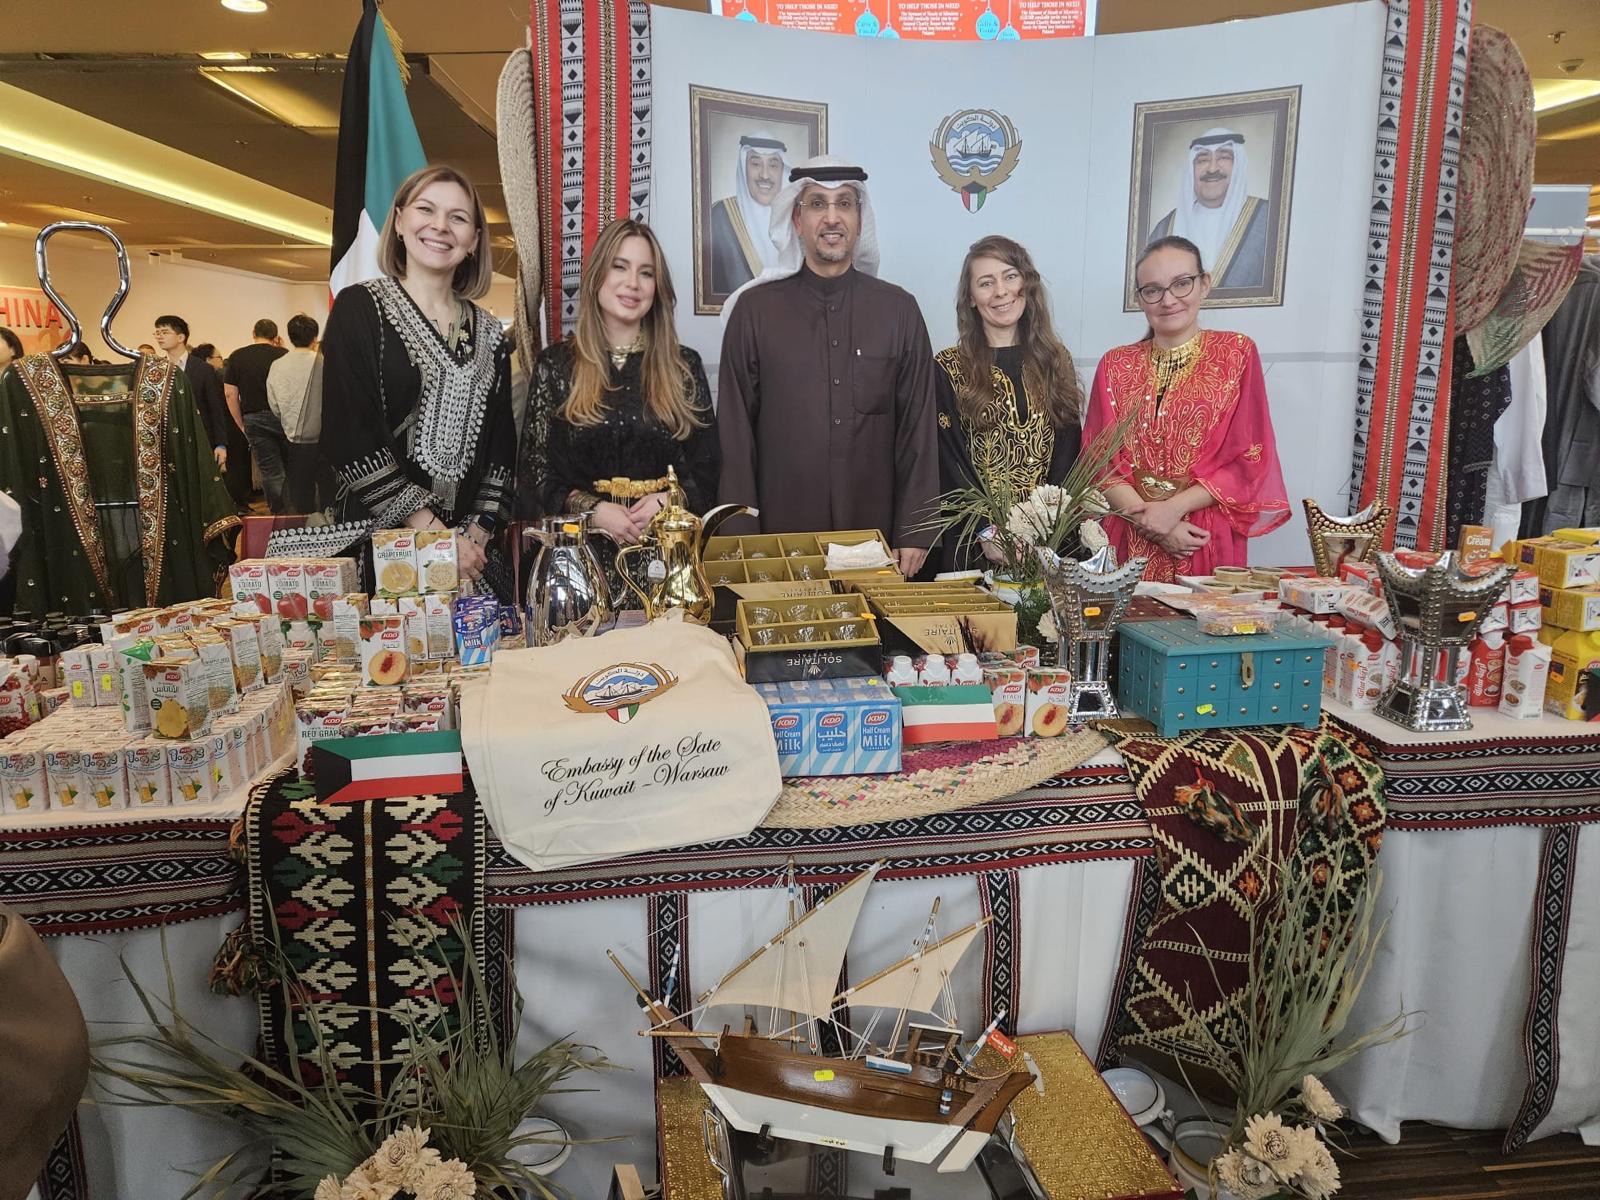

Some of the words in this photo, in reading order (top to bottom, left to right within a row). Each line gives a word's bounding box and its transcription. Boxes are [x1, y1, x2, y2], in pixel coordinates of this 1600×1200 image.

[1466, 536, 1491, 546] Cream
[786, 656, 842, 666] SOLITAIRE
[824, 716, 841, 724] KDD
[868, 714, 886, 722] KDD
[778, 719, 796, 727] KDD
[302, 730, 316, 738] RED
[784, 730, 801, 738] Cream
[818, 727, 846, 741] حليب
[874, 726, 890, 734] Cream
[862, 735, 890, 747] Milk
[541, 757, 625, 782] Embassy
[629, 745, 650, 772] of
[647, 744, 671, 763] the
[677, 732, 721, 760] Sate
[543, 791, 565, 817] of
[563, 779, 636, 806] Kuwait
[653, 756, 730, 787] Warsaw
